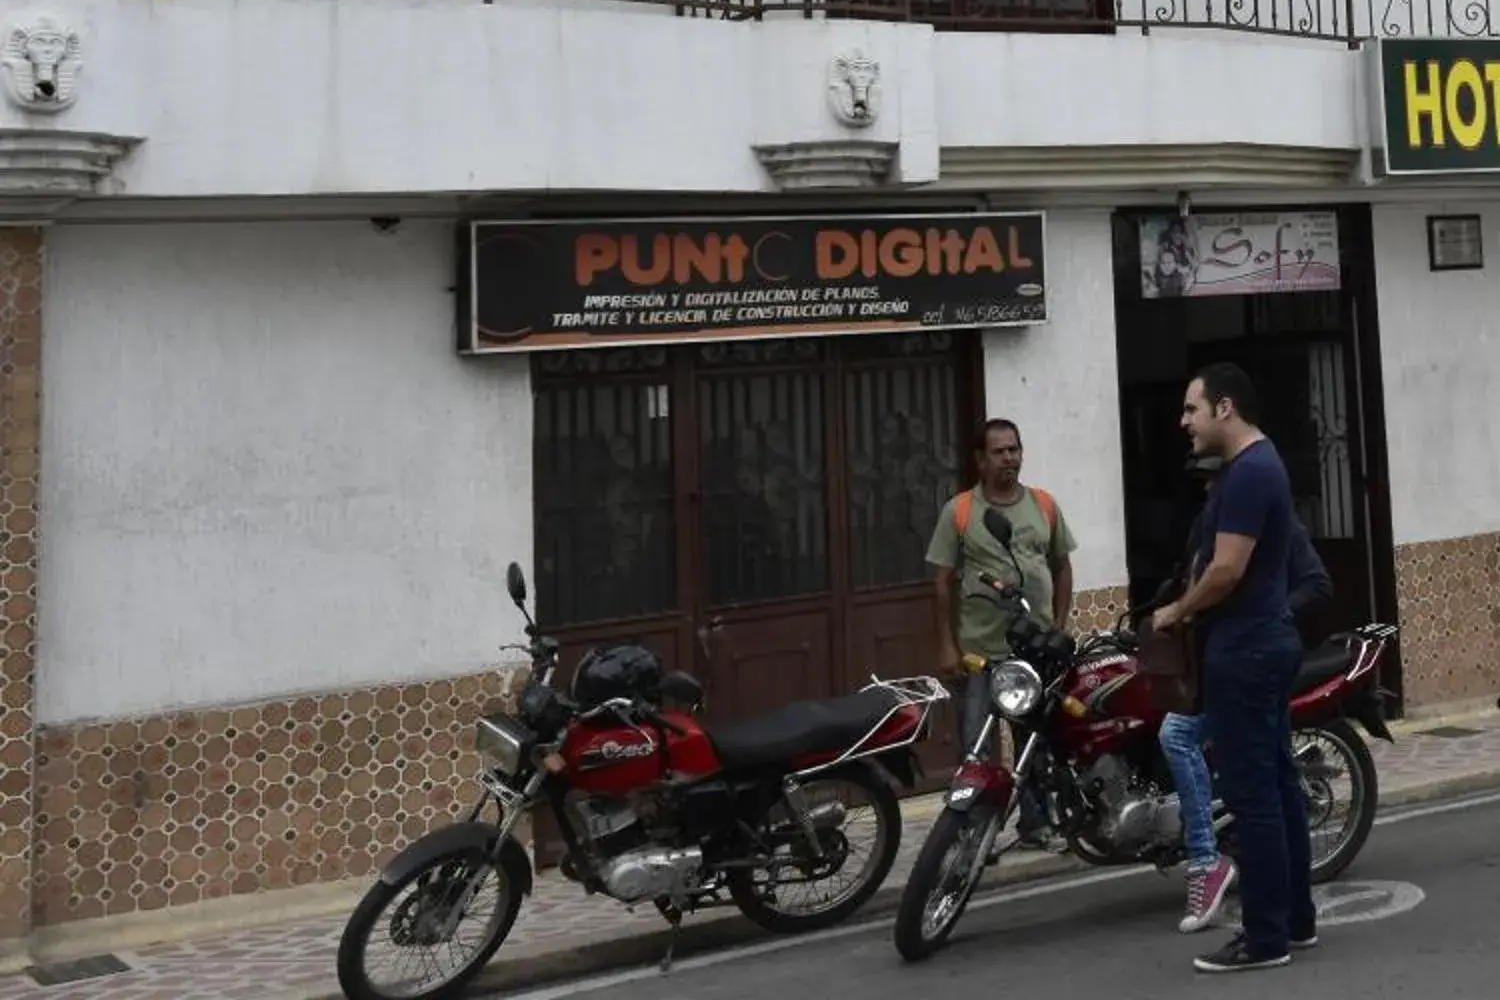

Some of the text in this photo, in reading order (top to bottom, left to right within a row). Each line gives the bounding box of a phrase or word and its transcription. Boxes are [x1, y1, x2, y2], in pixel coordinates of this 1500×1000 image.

[583, 290, 668, 309] IMPRESIÓN
[672, 293, 681, 307] Y
[684, 286, 799, 308] DIGITALIZACIÓN
[801, 287, 821, 302] DE
[552, 298, 910, 327] TRAMITE Y LICENCIA DE CONSTRUCCIÓN Y DISEÑO
